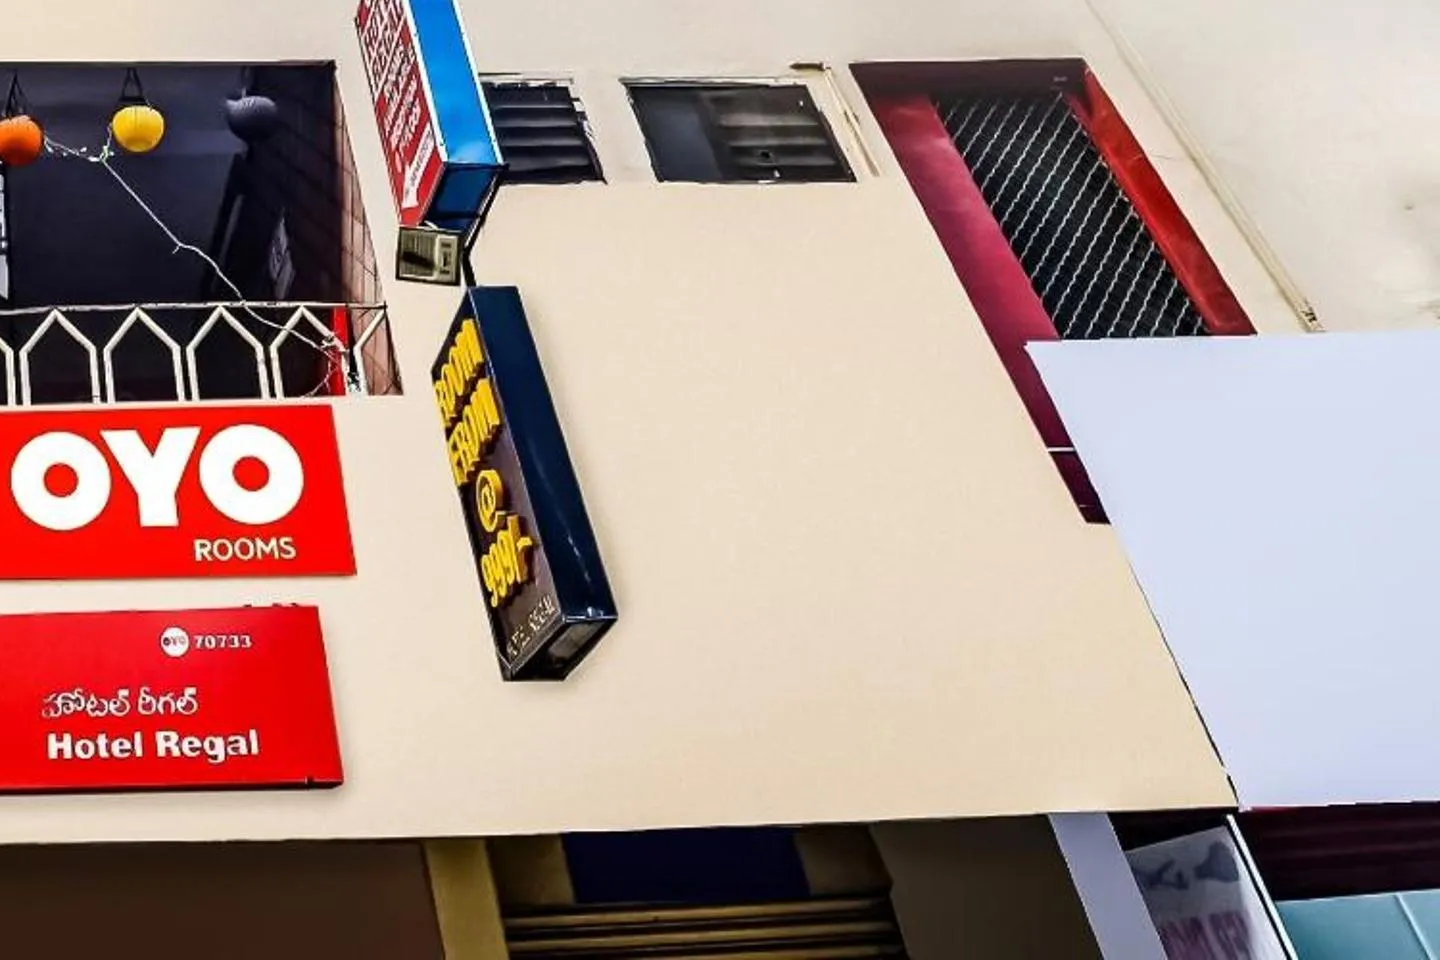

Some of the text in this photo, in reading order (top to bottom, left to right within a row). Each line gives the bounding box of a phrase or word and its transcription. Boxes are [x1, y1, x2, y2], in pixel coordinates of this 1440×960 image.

[434, 318, 484, 427] ROOM
[448, 378, 501, 488] FROM
[10, 424, 304, 531] OYO
[194, 537, 297, 562] ROOMS
[194, 634, 253, 649] 70733
[47, 729, 260, 764] Hotel Regal
